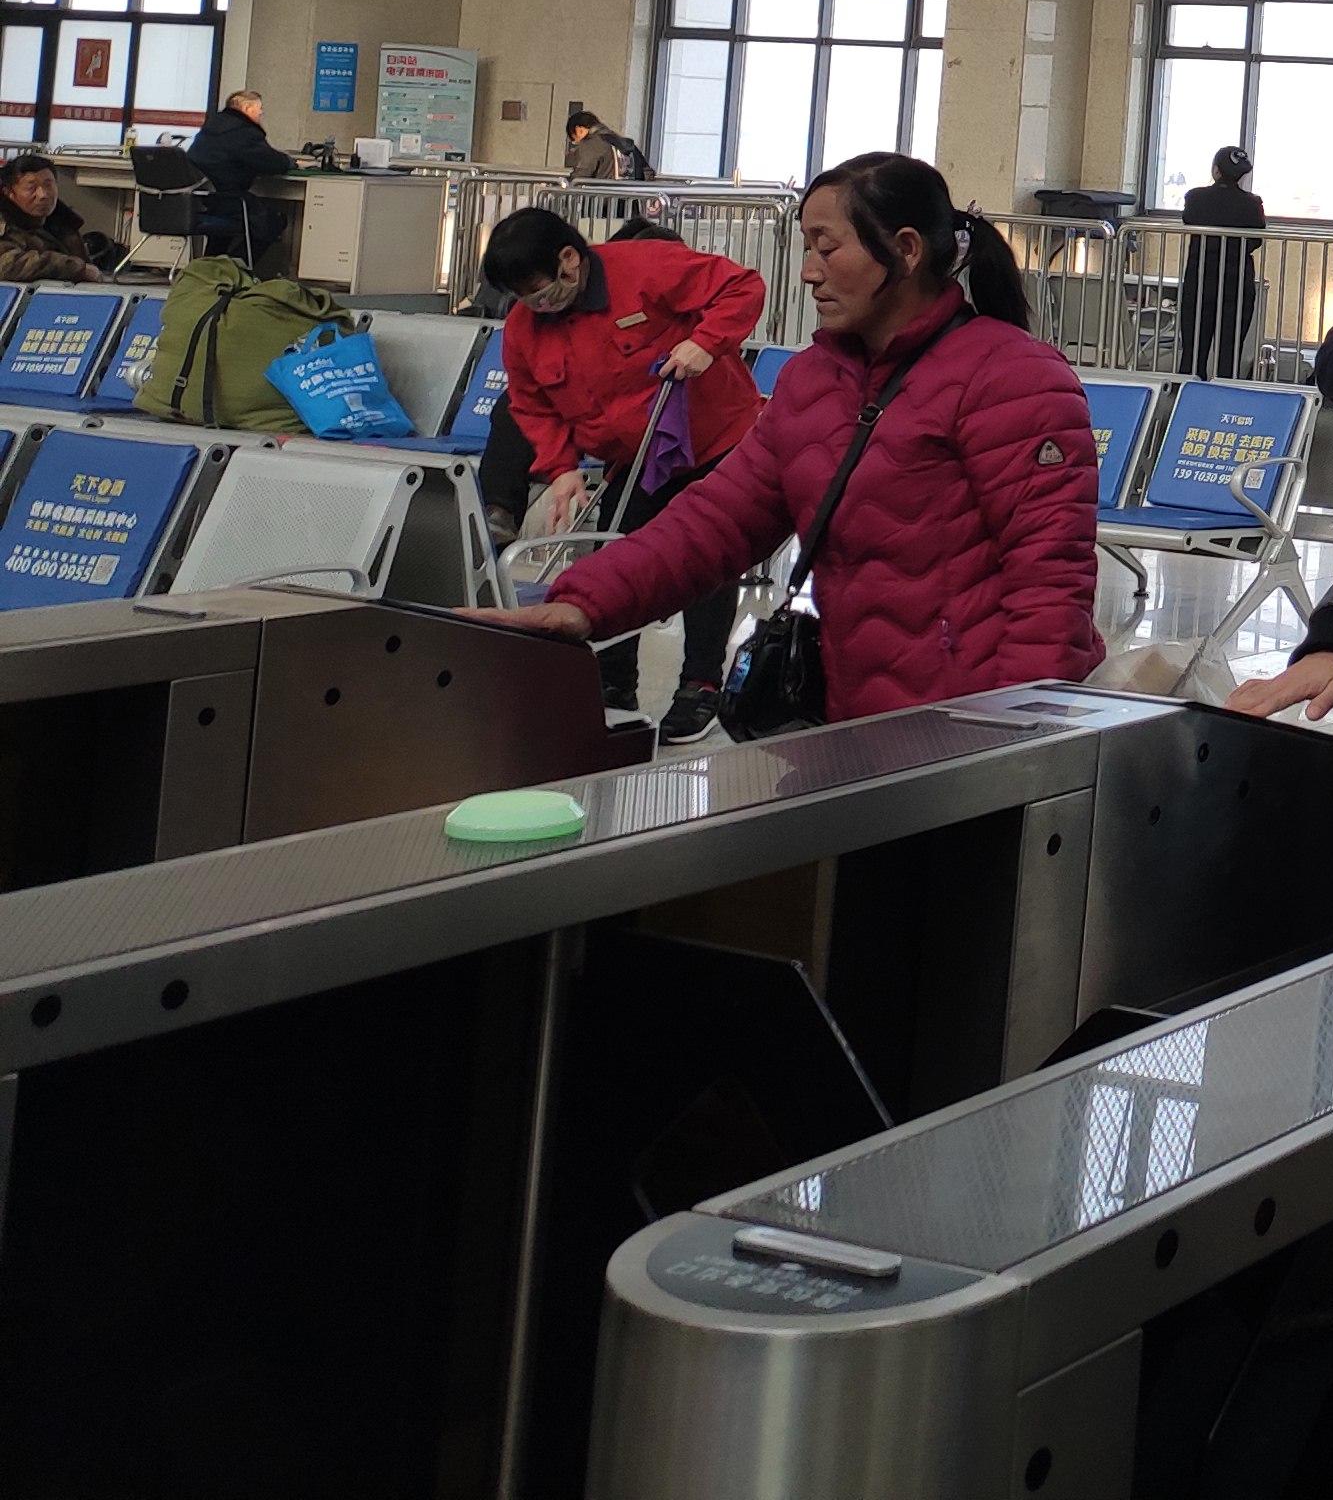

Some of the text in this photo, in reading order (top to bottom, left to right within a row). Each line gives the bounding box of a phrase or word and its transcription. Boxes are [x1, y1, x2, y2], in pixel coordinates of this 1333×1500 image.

[1172, 468, 1193, 480] 139
[1192, 470, 1217, 483] 1030
[4, 554, 32, 574] 400
[30, 558, 59, 578] 690
[56, 562, 94, 583] 9955
